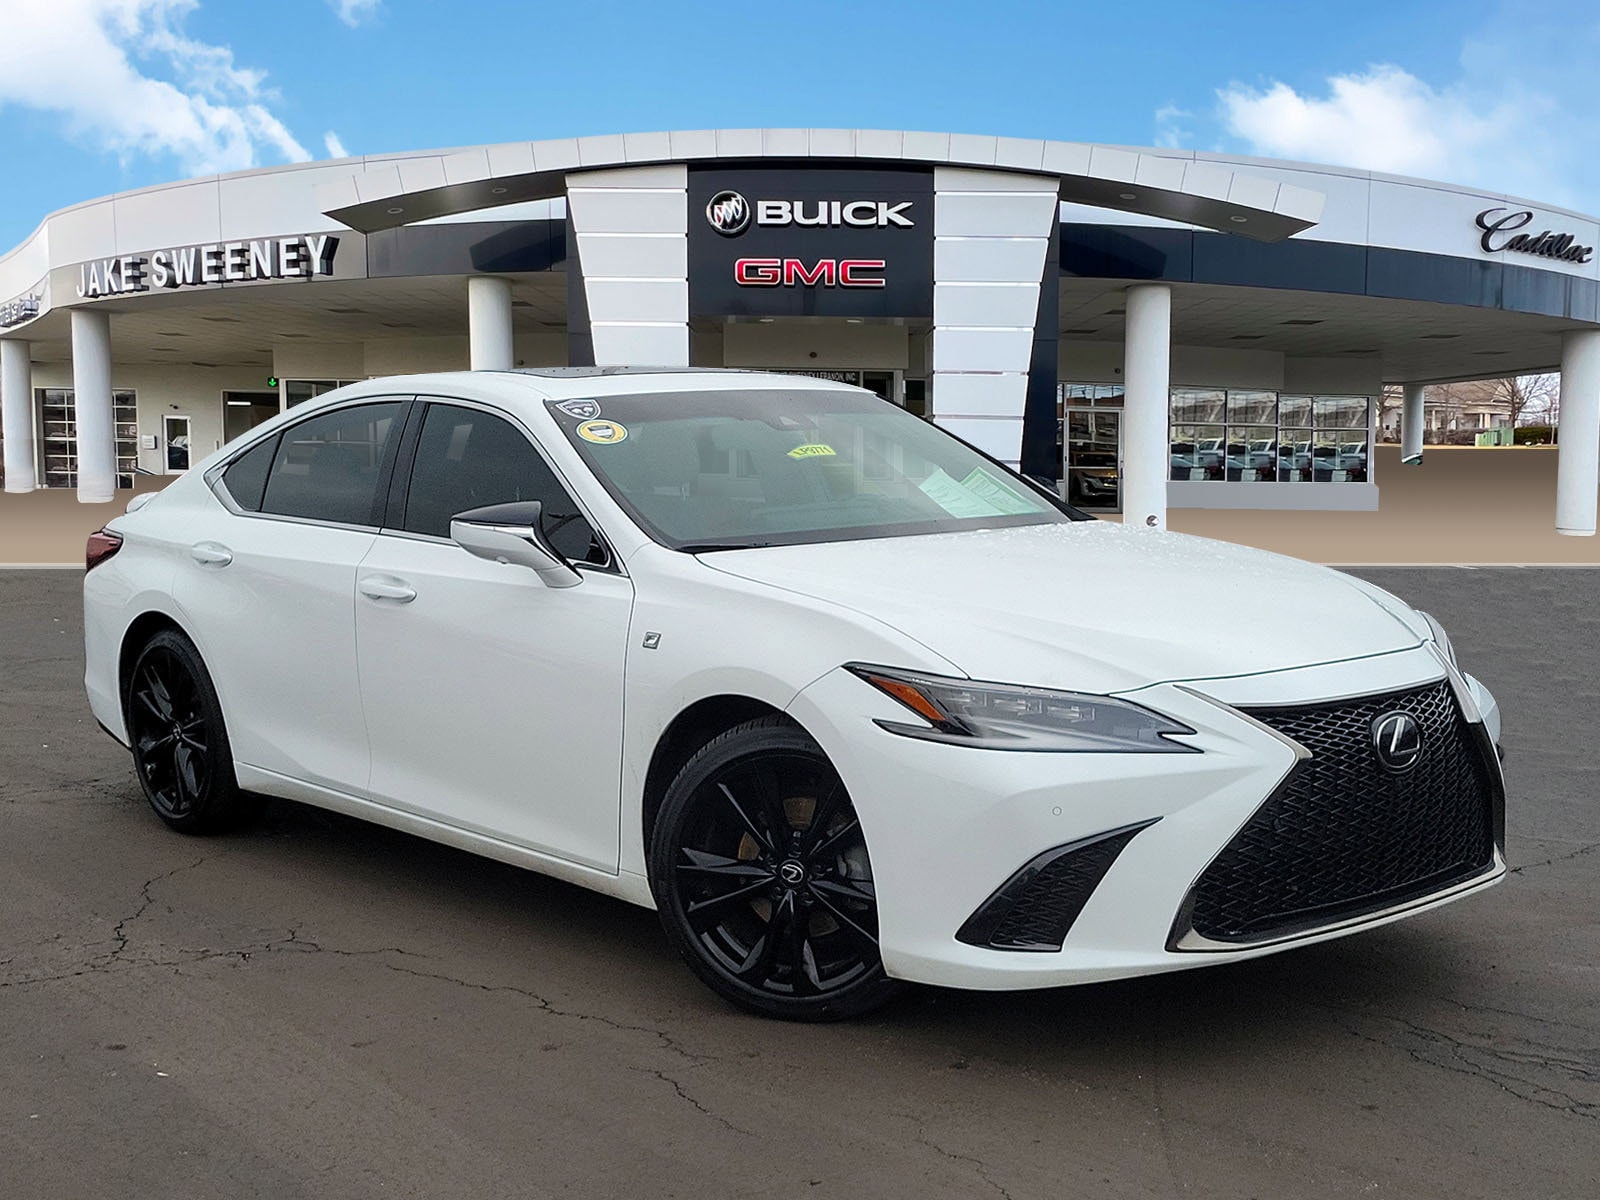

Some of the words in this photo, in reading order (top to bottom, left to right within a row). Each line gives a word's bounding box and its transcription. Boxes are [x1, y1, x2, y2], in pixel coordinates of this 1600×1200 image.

[757, 200, 915, 227] BUICK
[1475, 207, 1594, 264] Cadillac
[76, 255, 141, 299] JAKE
[151, 234, 333, 289] SWEENEY
[734, 258, 886, 287] GMC
